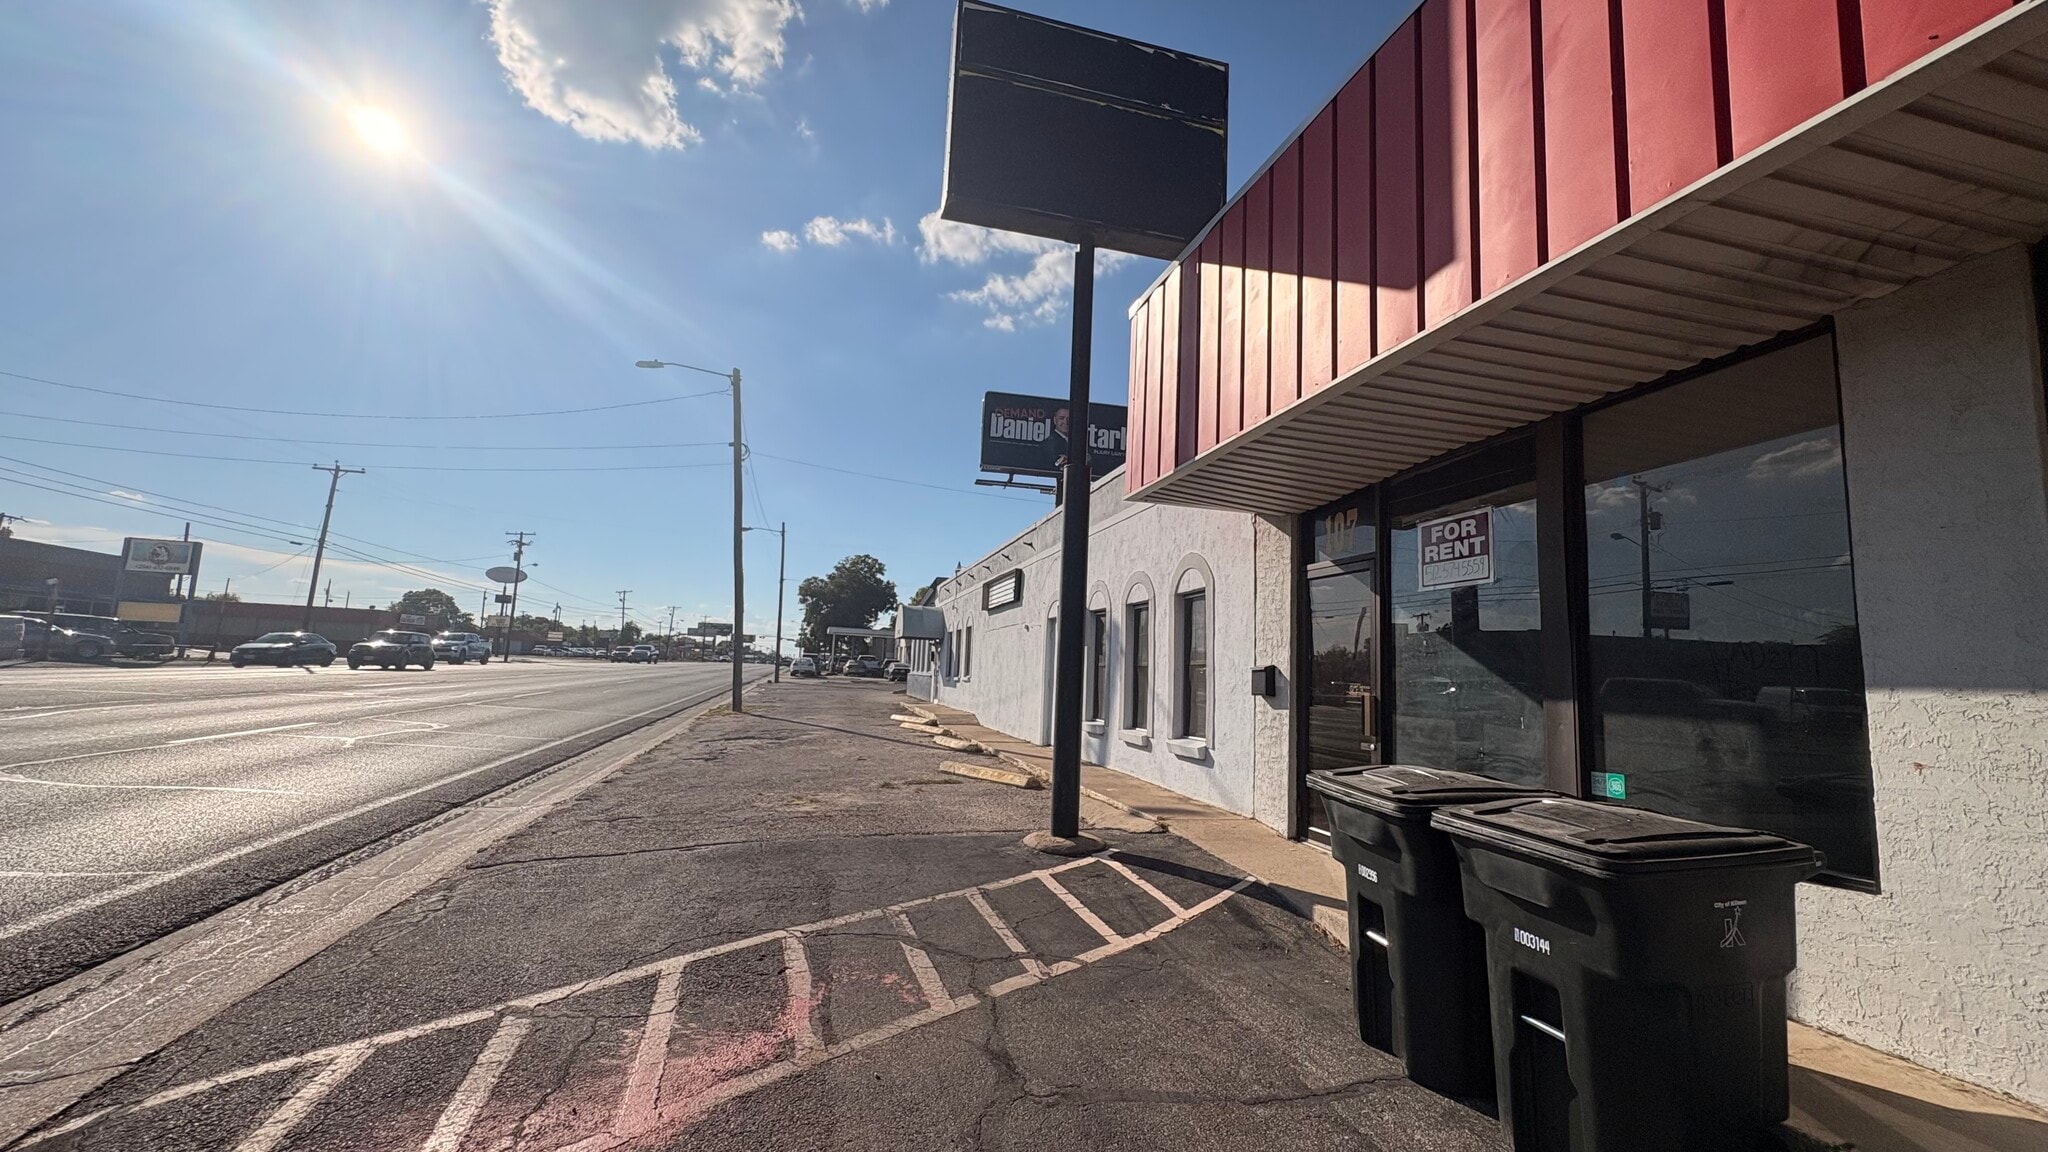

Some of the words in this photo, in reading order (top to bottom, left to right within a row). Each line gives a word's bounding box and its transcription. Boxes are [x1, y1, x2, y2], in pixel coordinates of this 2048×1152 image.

[995, 408, 1045, 419] DEMAND
[990, 413, 1051, 442] Daniel
[1325, 508, 1358, 553] 107
[1431, 518, 1477, 543] FOR
[1425, 536, 1485, 563] RENT
